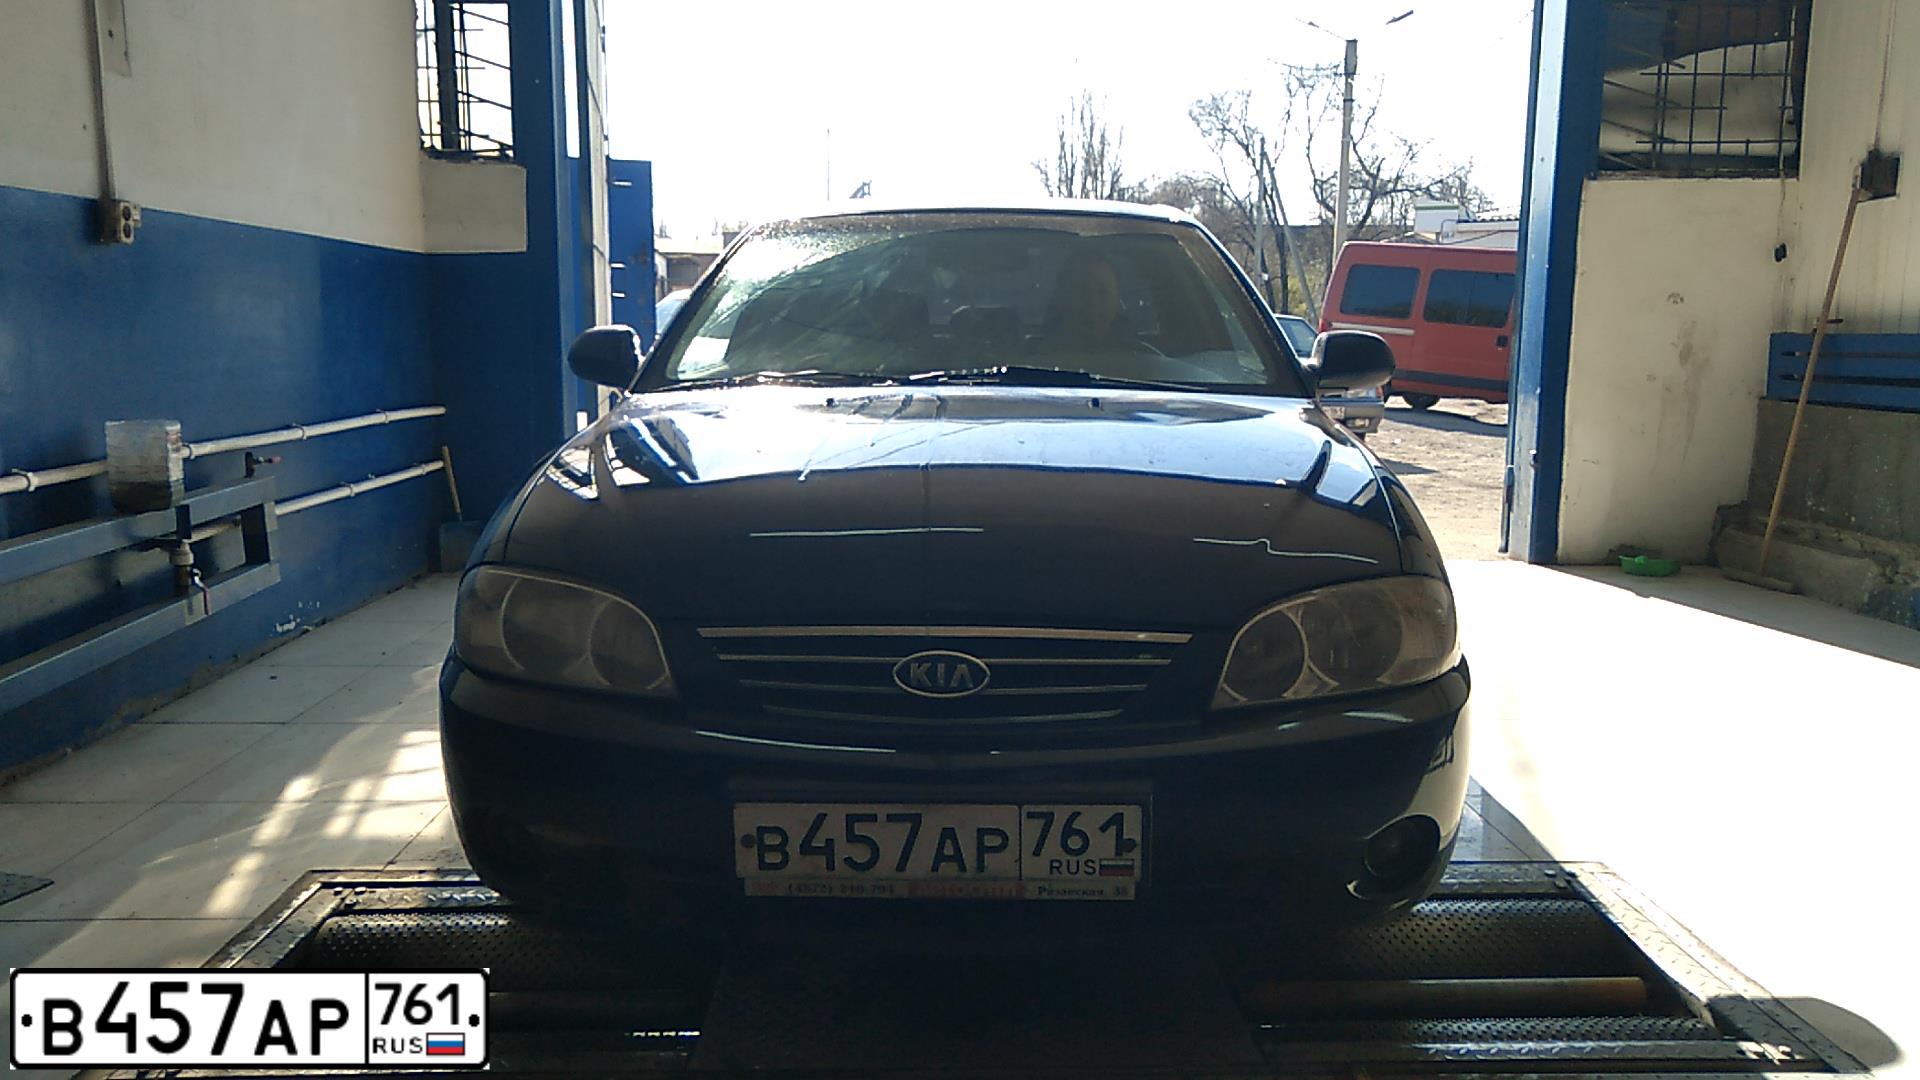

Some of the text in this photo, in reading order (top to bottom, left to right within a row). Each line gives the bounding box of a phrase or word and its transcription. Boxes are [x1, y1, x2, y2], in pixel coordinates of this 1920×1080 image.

[909, 663, 974, 688] KIA
[756, 811, 1126, 873] В457АР 761
[1049, 859, 1097, 875] RUS
